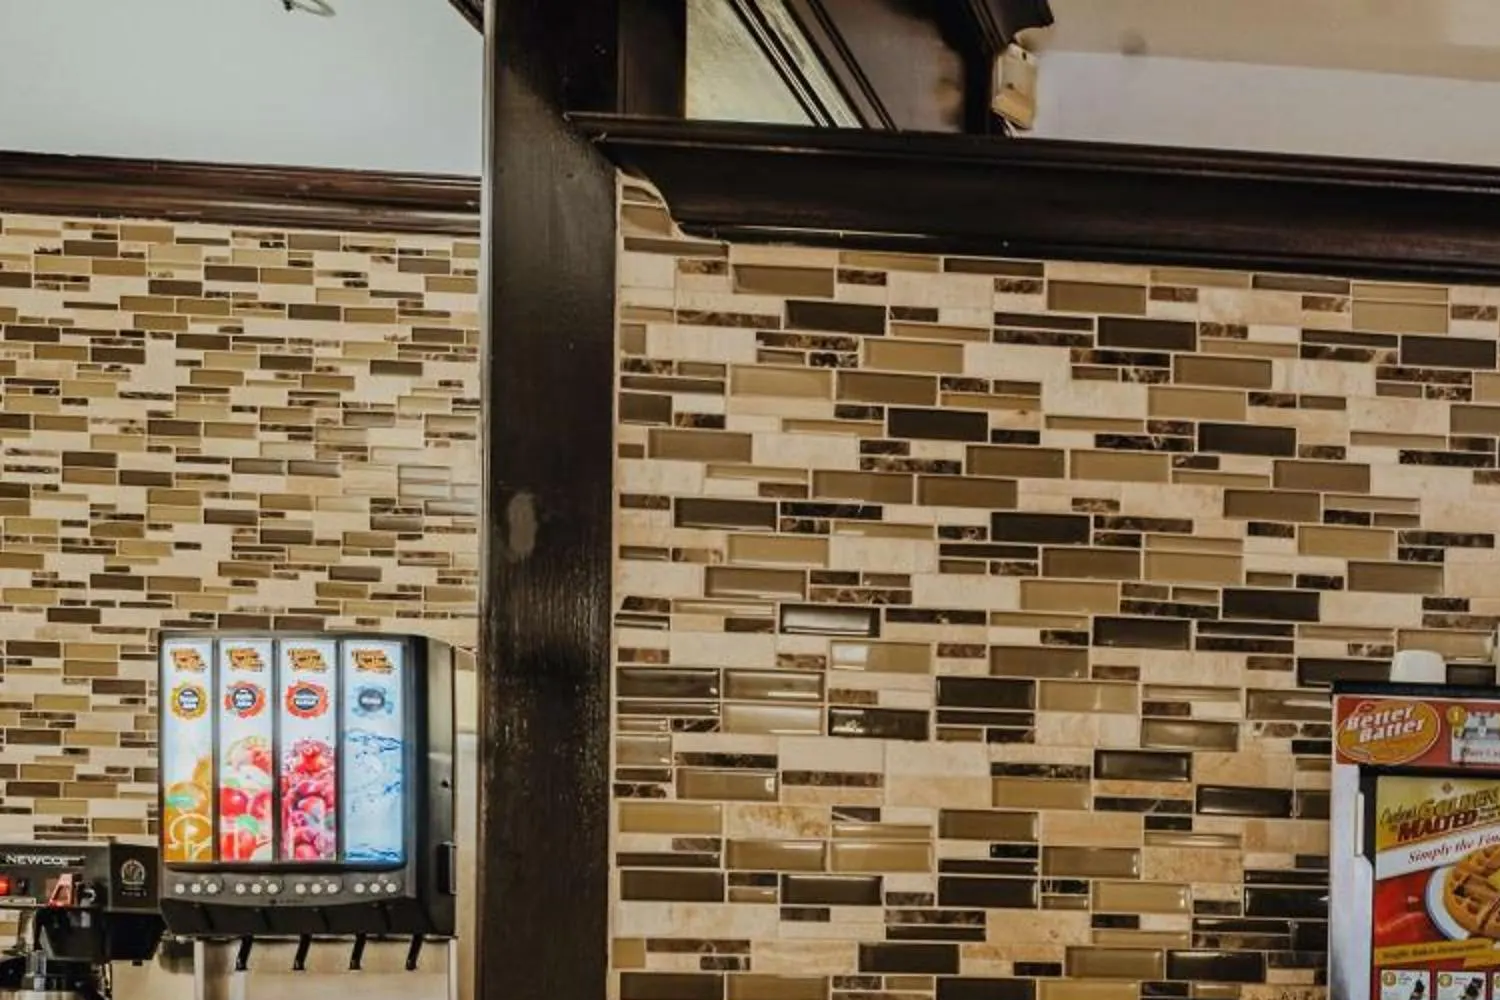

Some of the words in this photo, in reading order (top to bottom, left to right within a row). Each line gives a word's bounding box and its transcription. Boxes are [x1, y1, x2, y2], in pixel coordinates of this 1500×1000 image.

[1345, 706, 1415, 731] Better
[1359, 717, 1425, 743] Batter
[1397, 809, 1480, 843] MALTED
[5, 855, 63, 866] NEWCO
[1408, 843, 1453, 865] Simply
[1454, 837, 1474, 853] the
